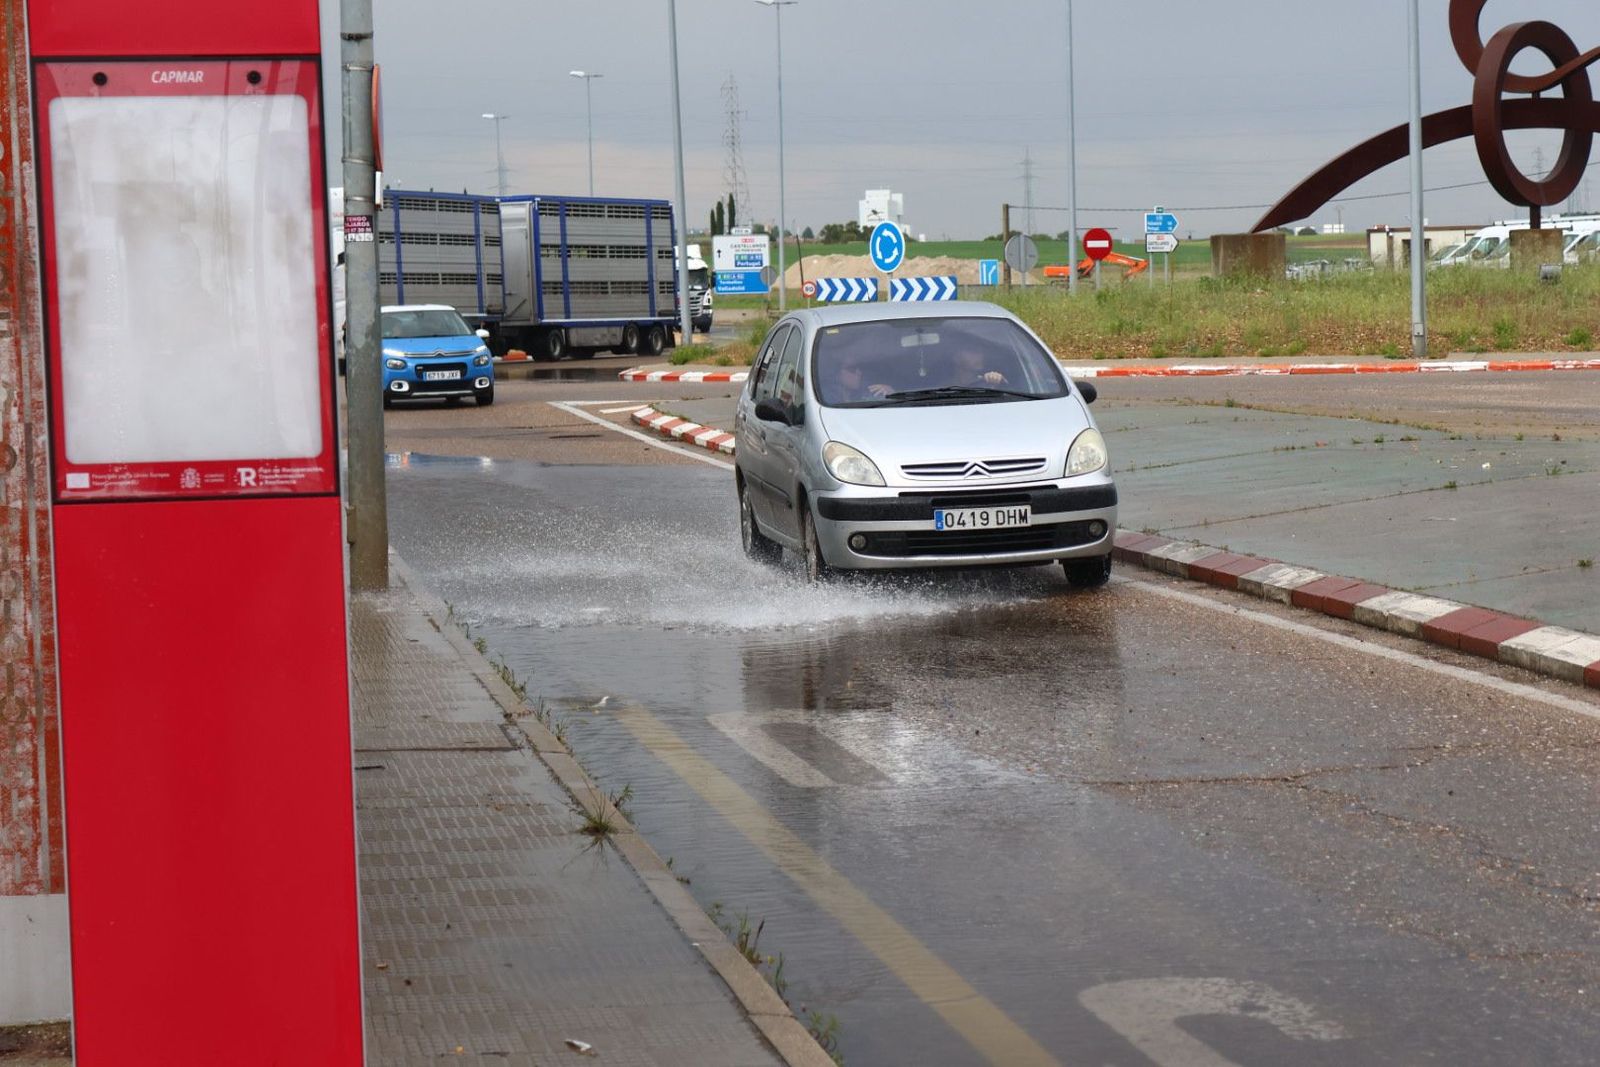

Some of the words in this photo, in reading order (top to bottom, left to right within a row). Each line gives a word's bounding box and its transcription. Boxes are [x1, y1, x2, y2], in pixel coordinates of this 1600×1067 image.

[151, 70, 204, 83] CAPMAR
[944, 511, 989, 528] 0419
[996, 508, 1028, 525] DHM
